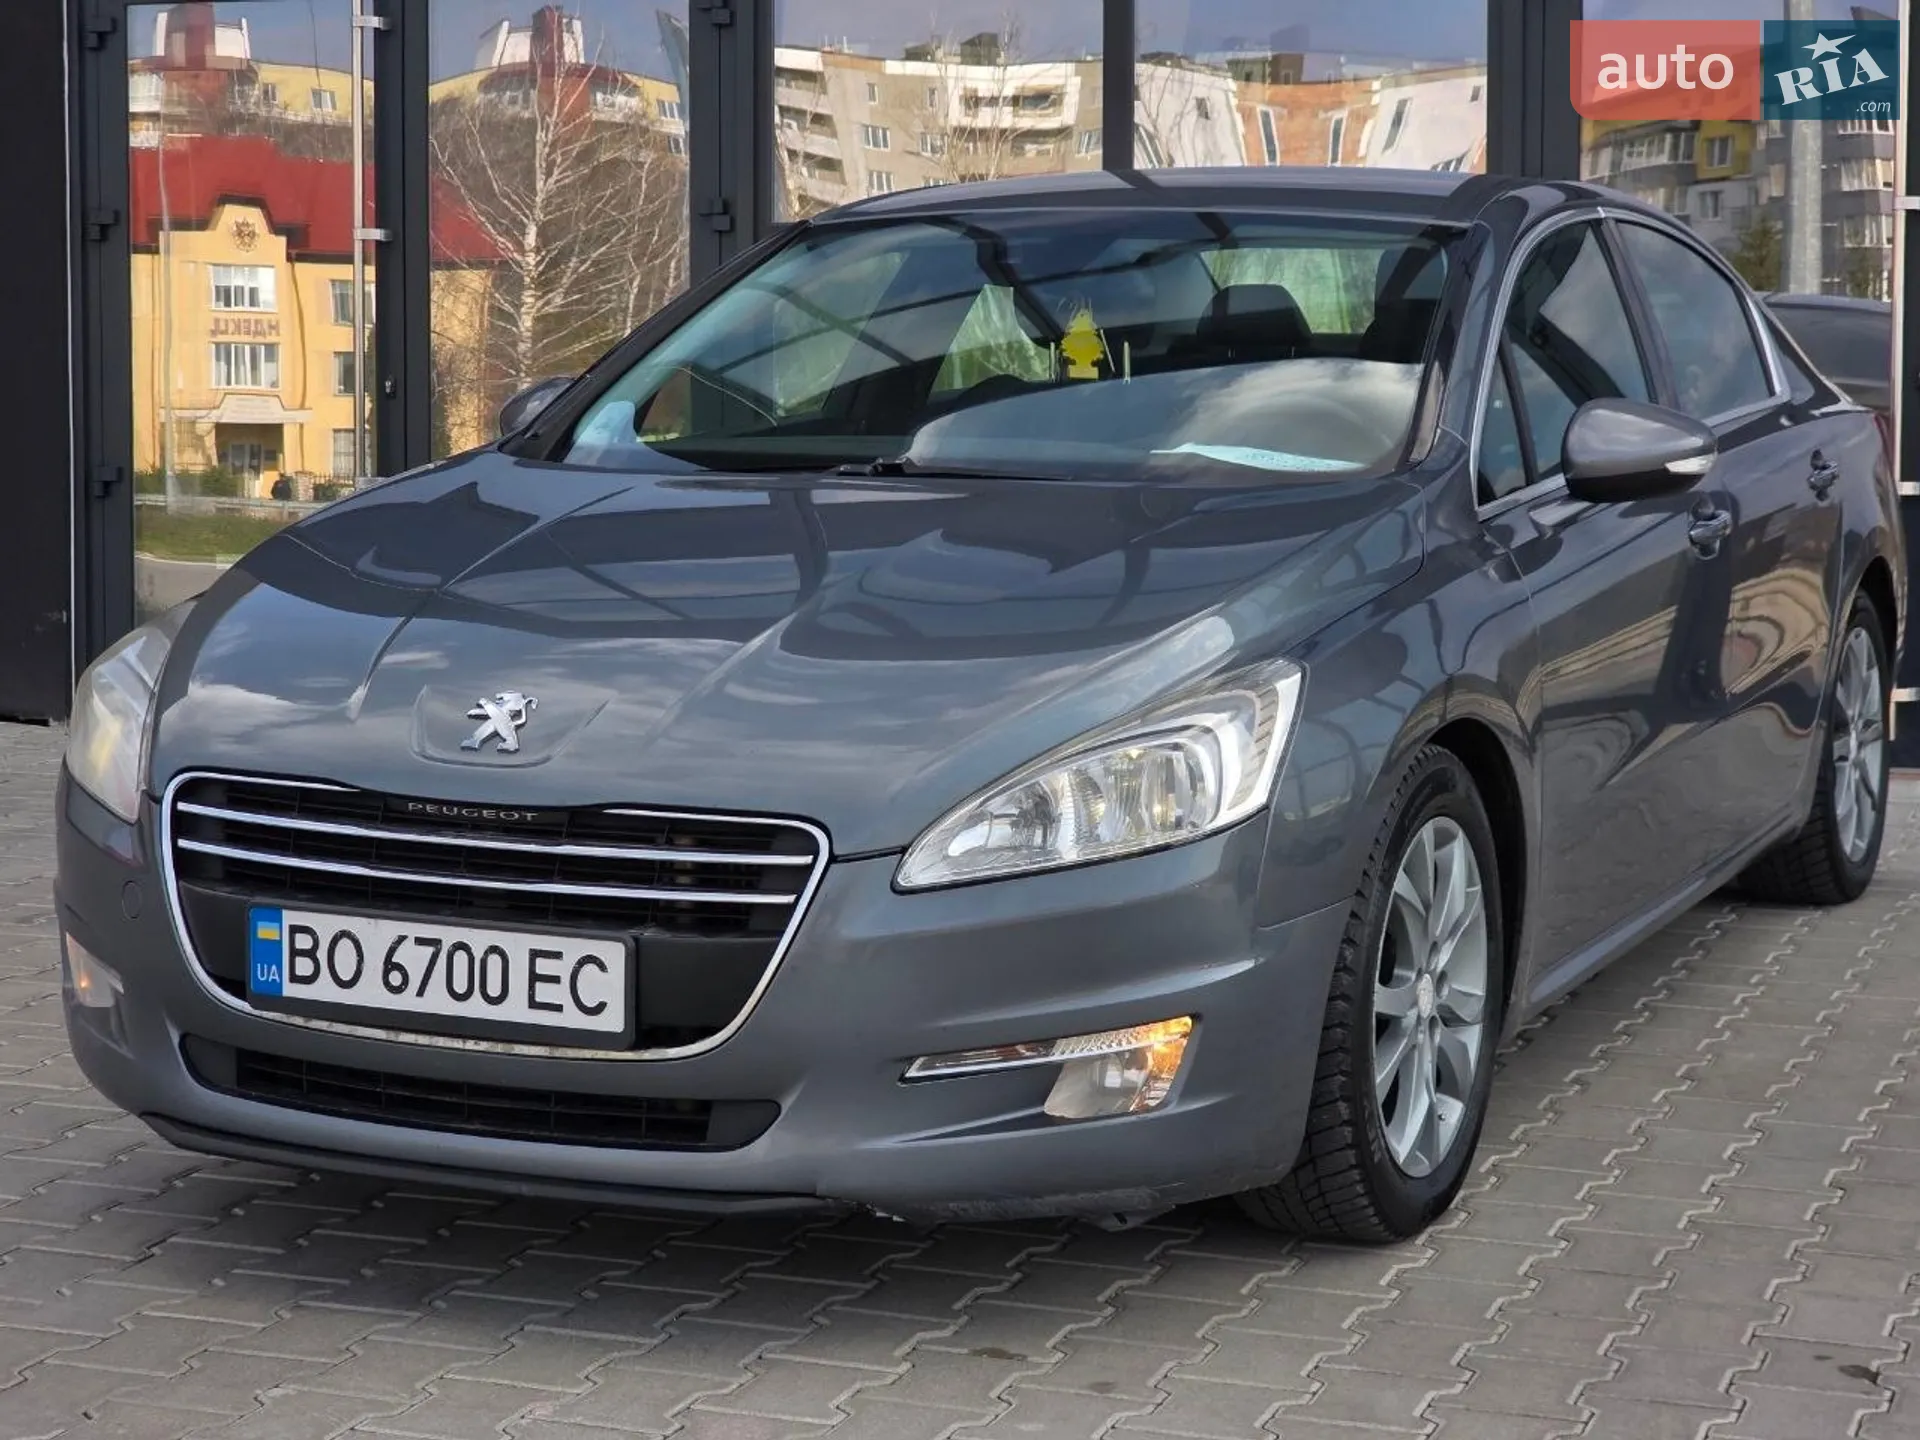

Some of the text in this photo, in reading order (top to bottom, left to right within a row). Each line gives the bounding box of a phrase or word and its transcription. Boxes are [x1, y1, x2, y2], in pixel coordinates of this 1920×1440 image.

[407, 802, 539, 821] PEUGEOT
[256, 962, 280, 983] UA
[288, 923, 609, 1017] BO 6700 EC
